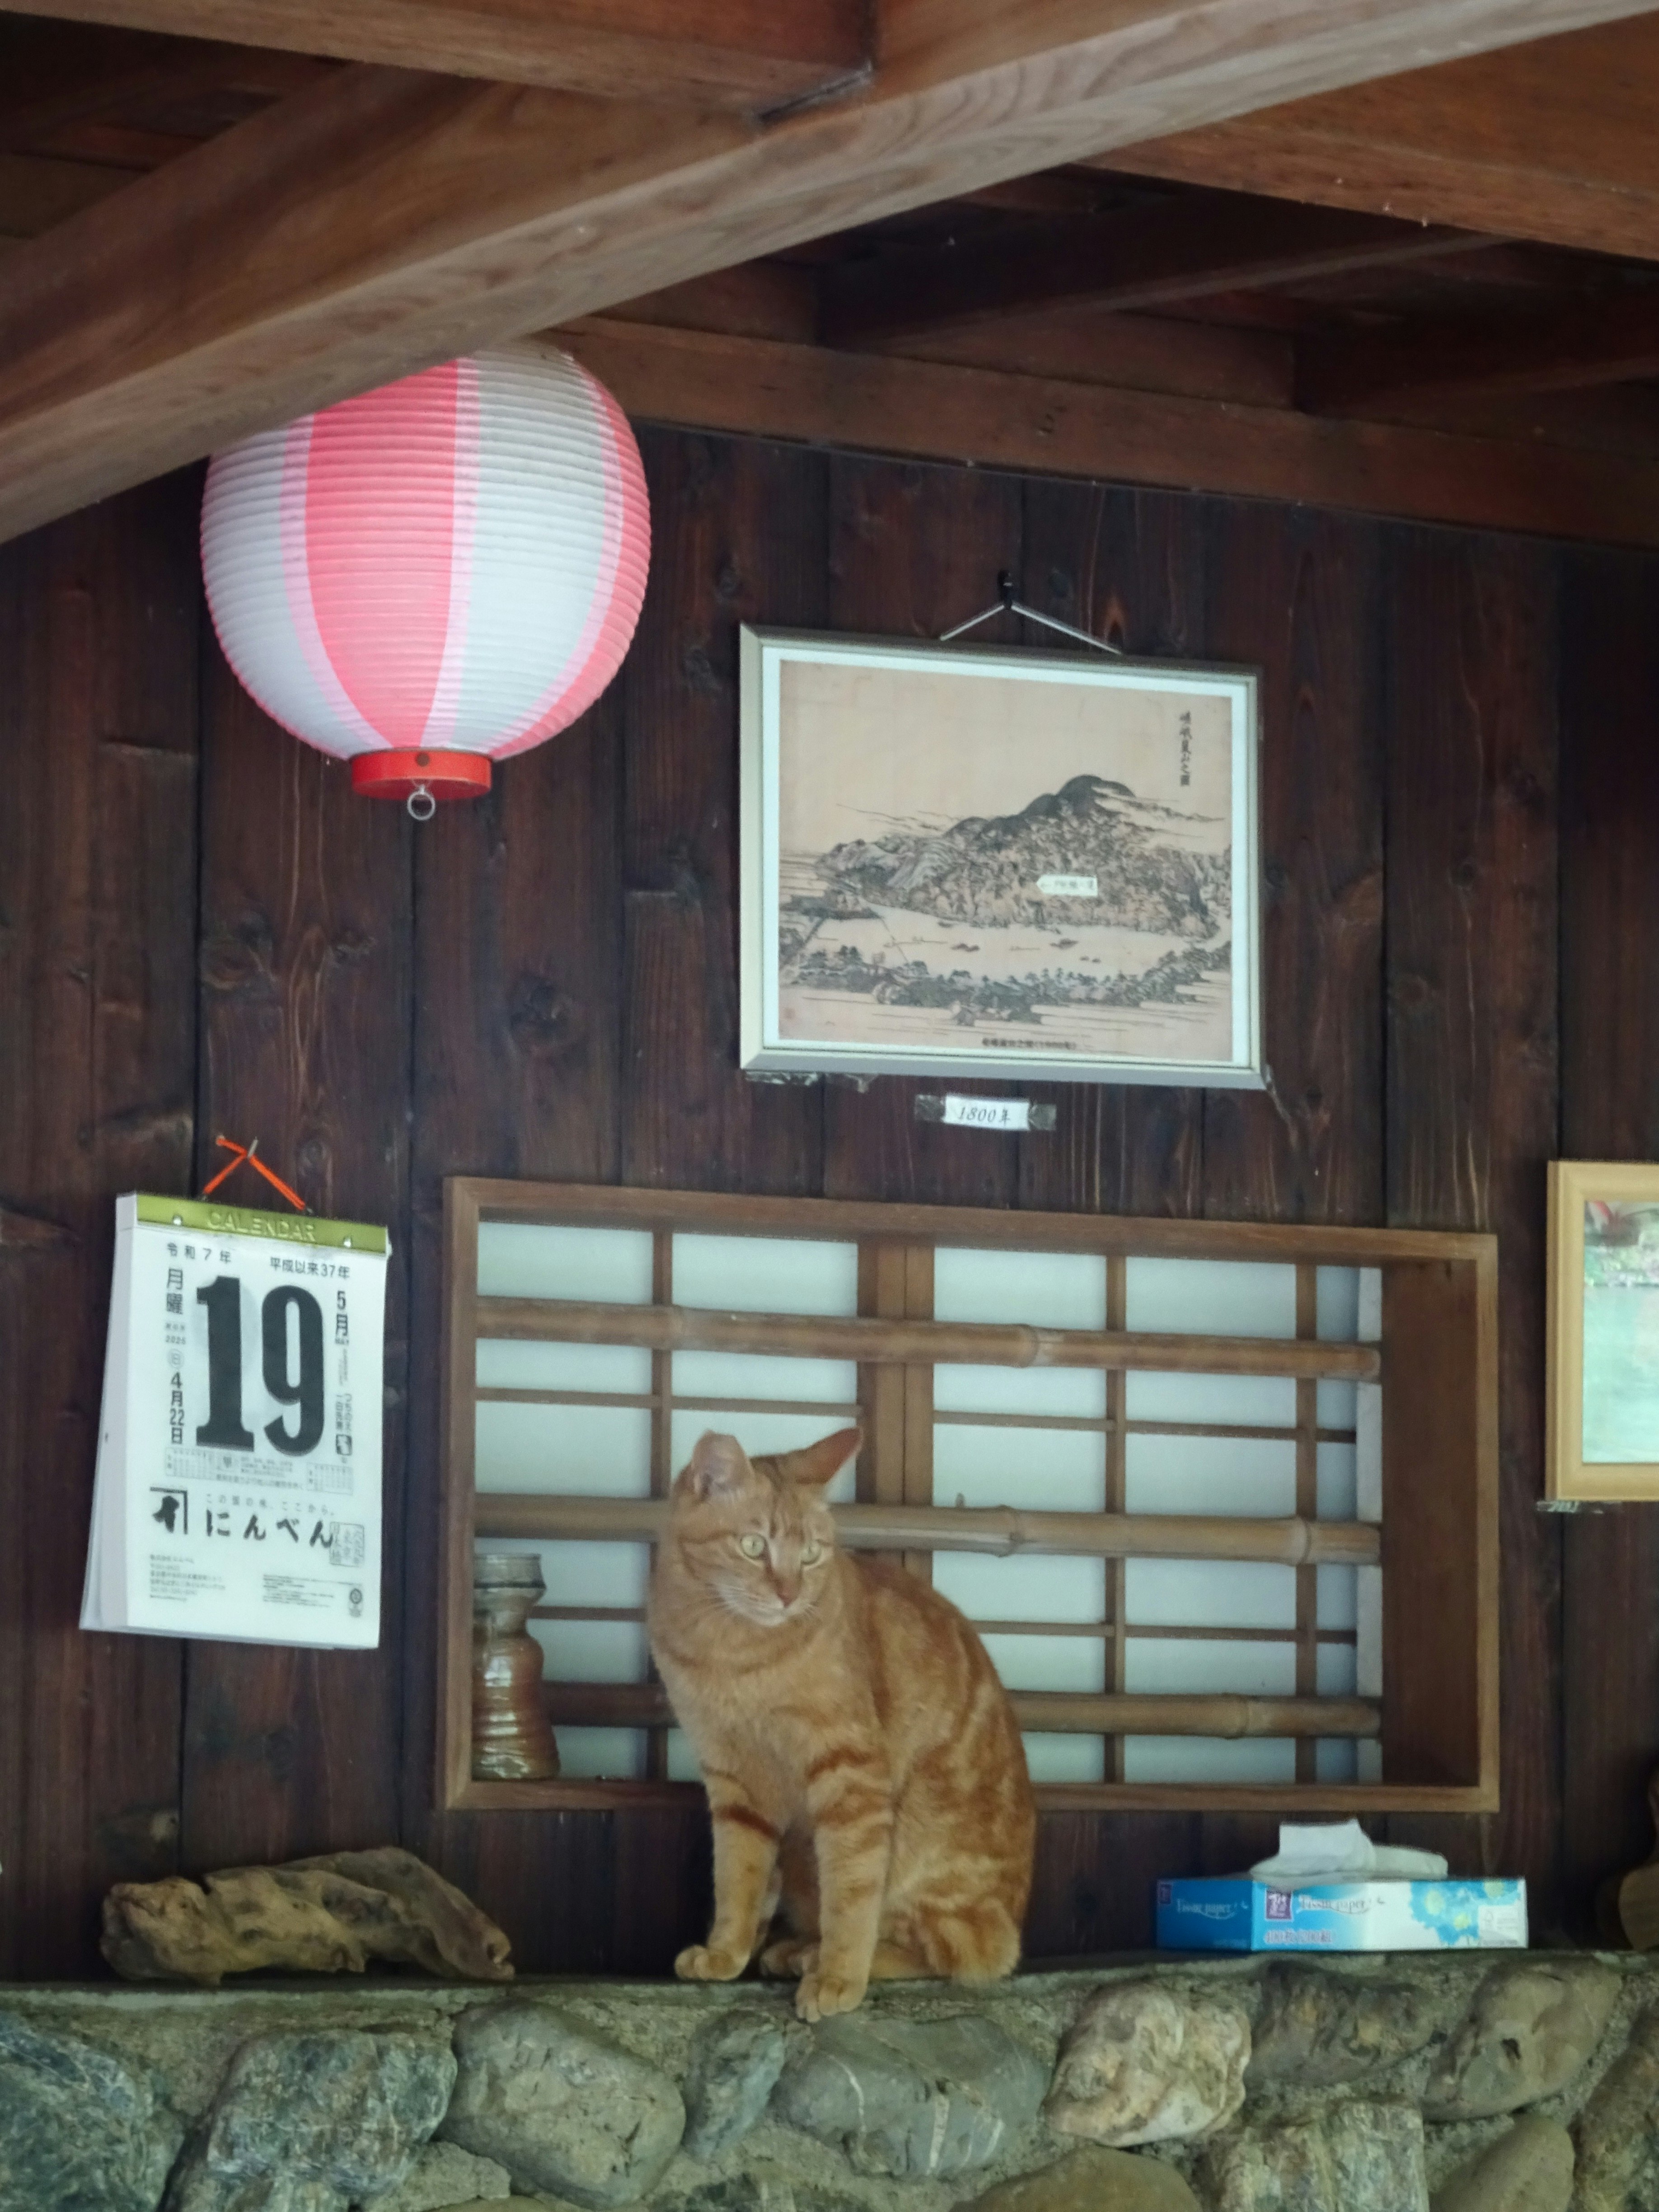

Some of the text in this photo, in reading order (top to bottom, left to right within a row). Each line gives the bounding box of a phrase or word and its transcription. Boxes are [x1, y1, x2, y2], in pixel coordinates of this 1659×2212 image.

[206, 1211, 316, 1242] CALENDAR
[167, 1242, 231, 1263] 令和7年
[271, 1257, 350, 1279] 平成以来37年
[196, 1275, 324, 1456] 19
[170, 1372, 184, 1444] 4月22日
[206, 1509, 333, 1548] にんべん
